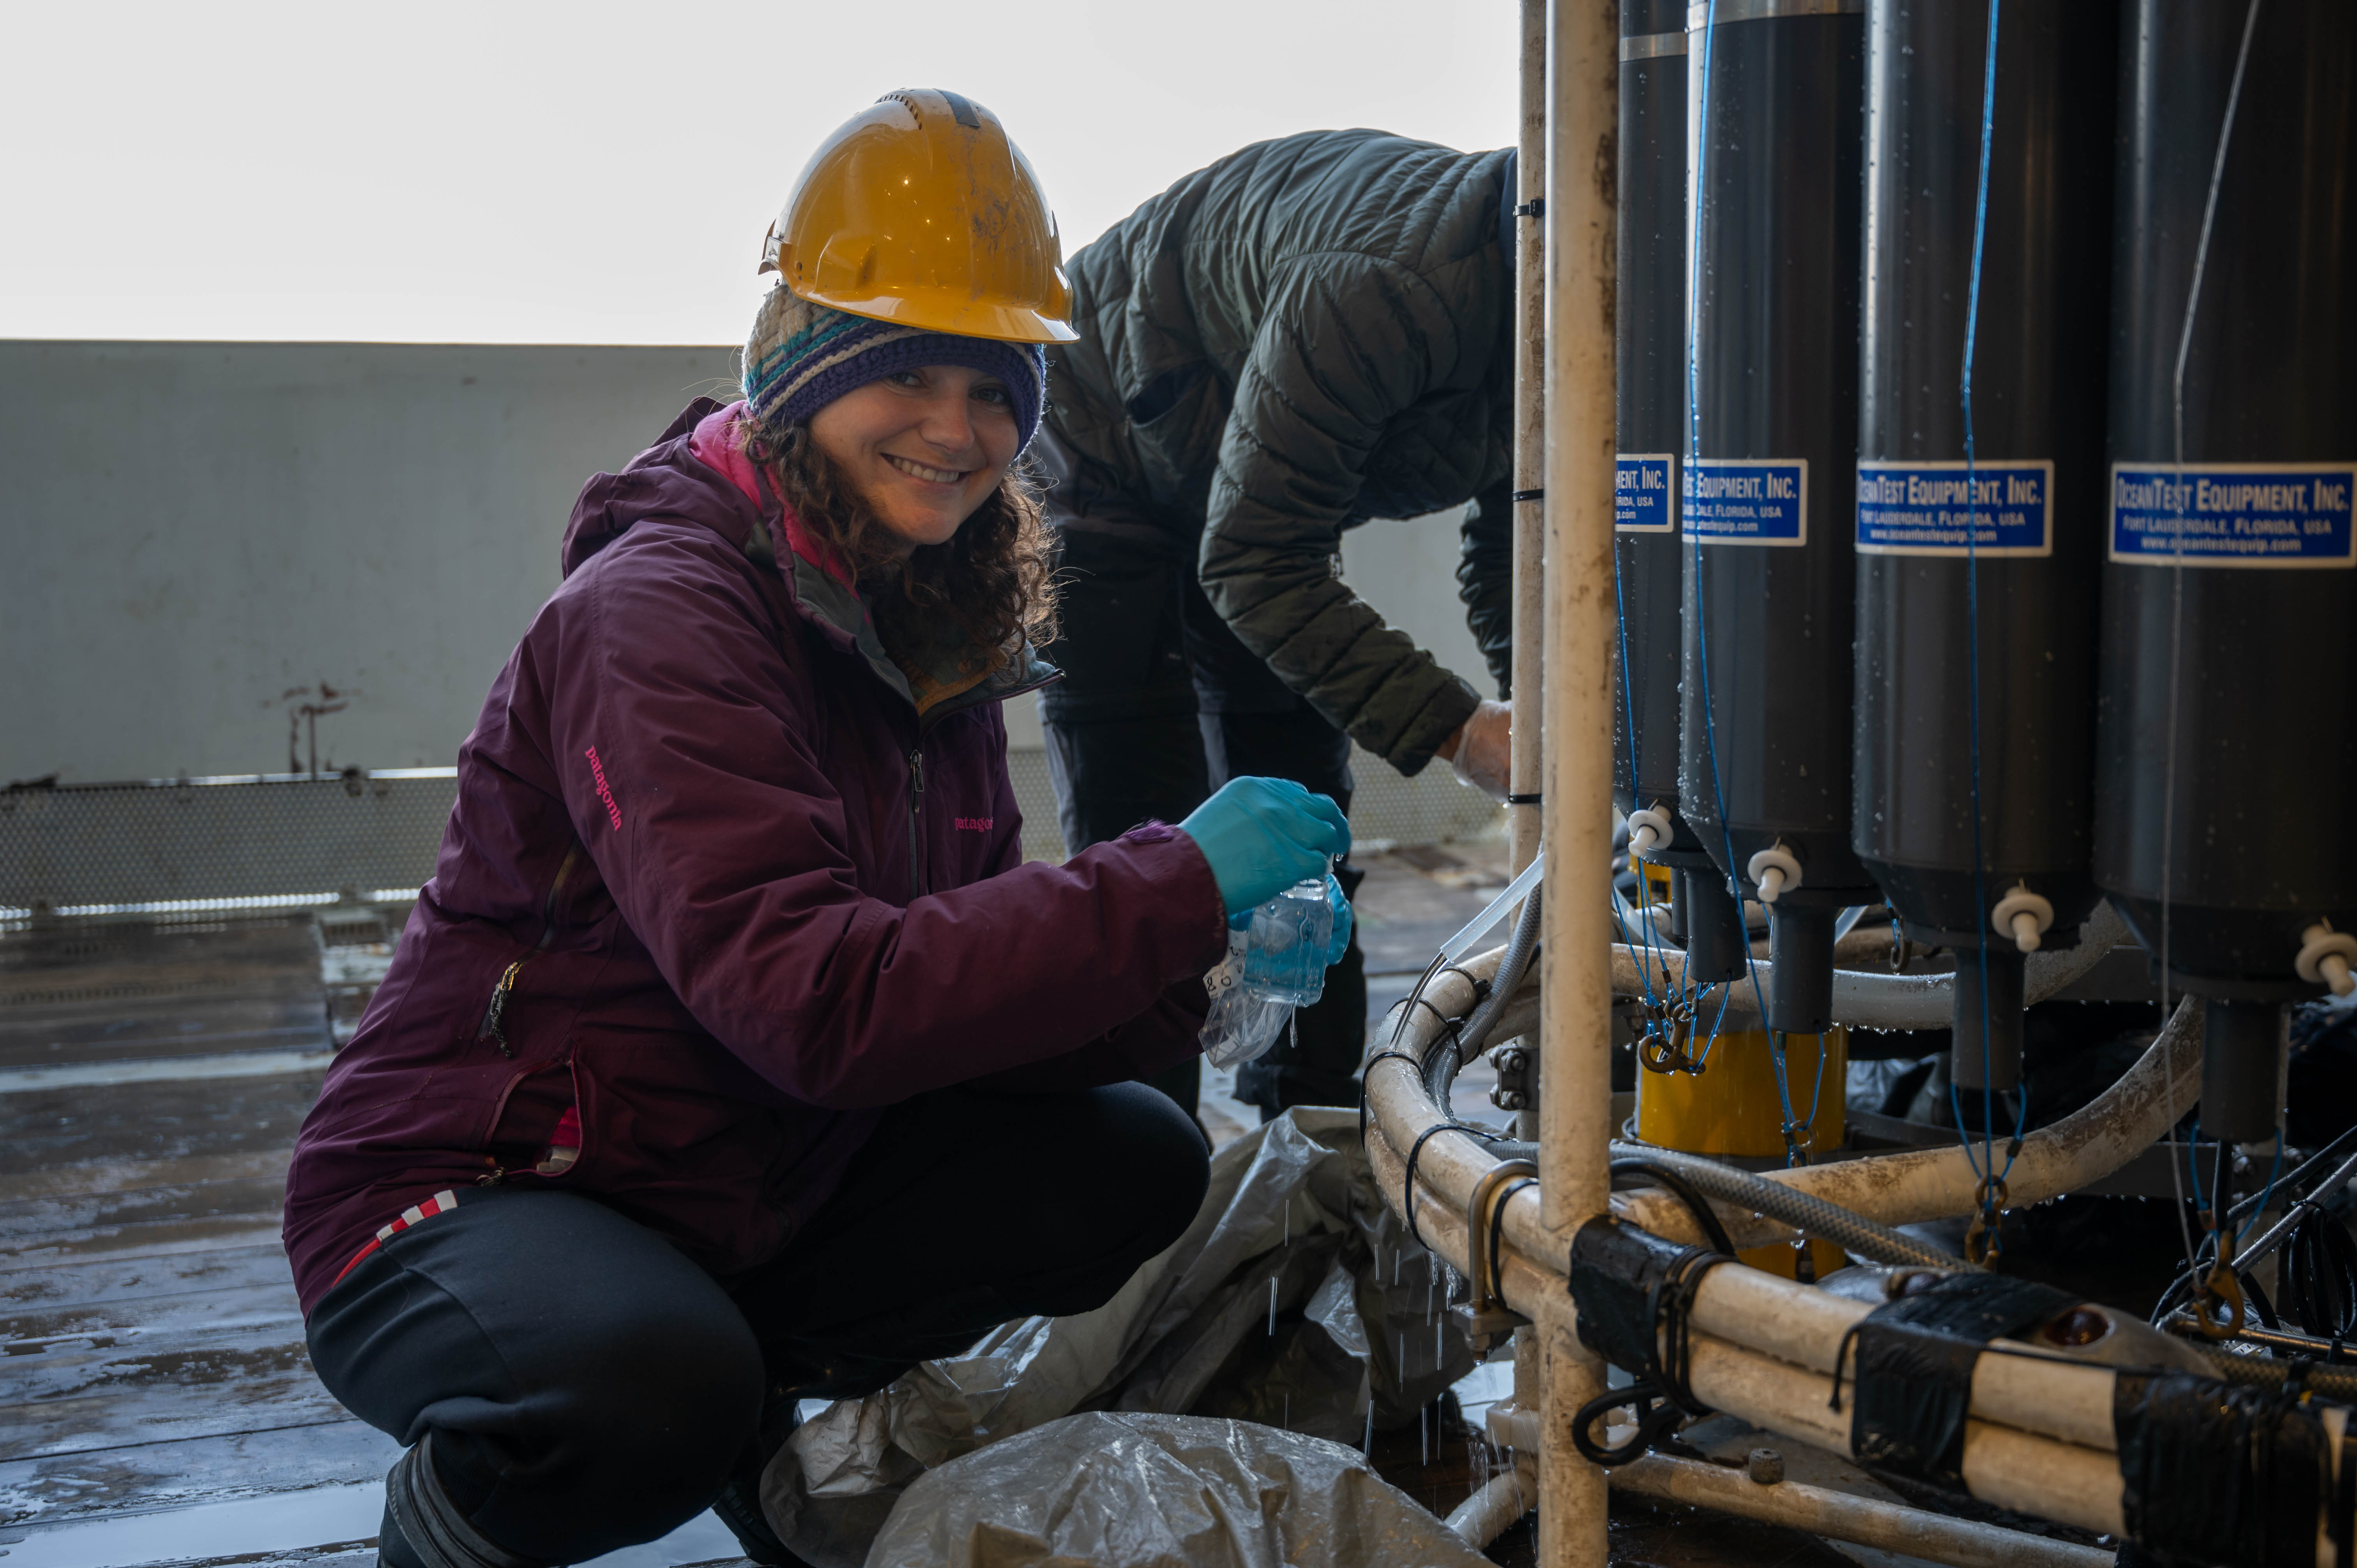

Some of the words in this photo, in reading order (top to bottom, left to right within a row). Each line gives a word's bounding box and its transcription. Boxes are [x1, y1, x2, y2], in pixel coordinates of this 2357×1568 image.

[1637, 497, 1654, 507] USA
[1760, 506, 1782, 518] USA
[1998, 512, 2026, 526] USA
[2303, 519, 2332, 535] USA
[585, 745, 622, 831] patagonia
